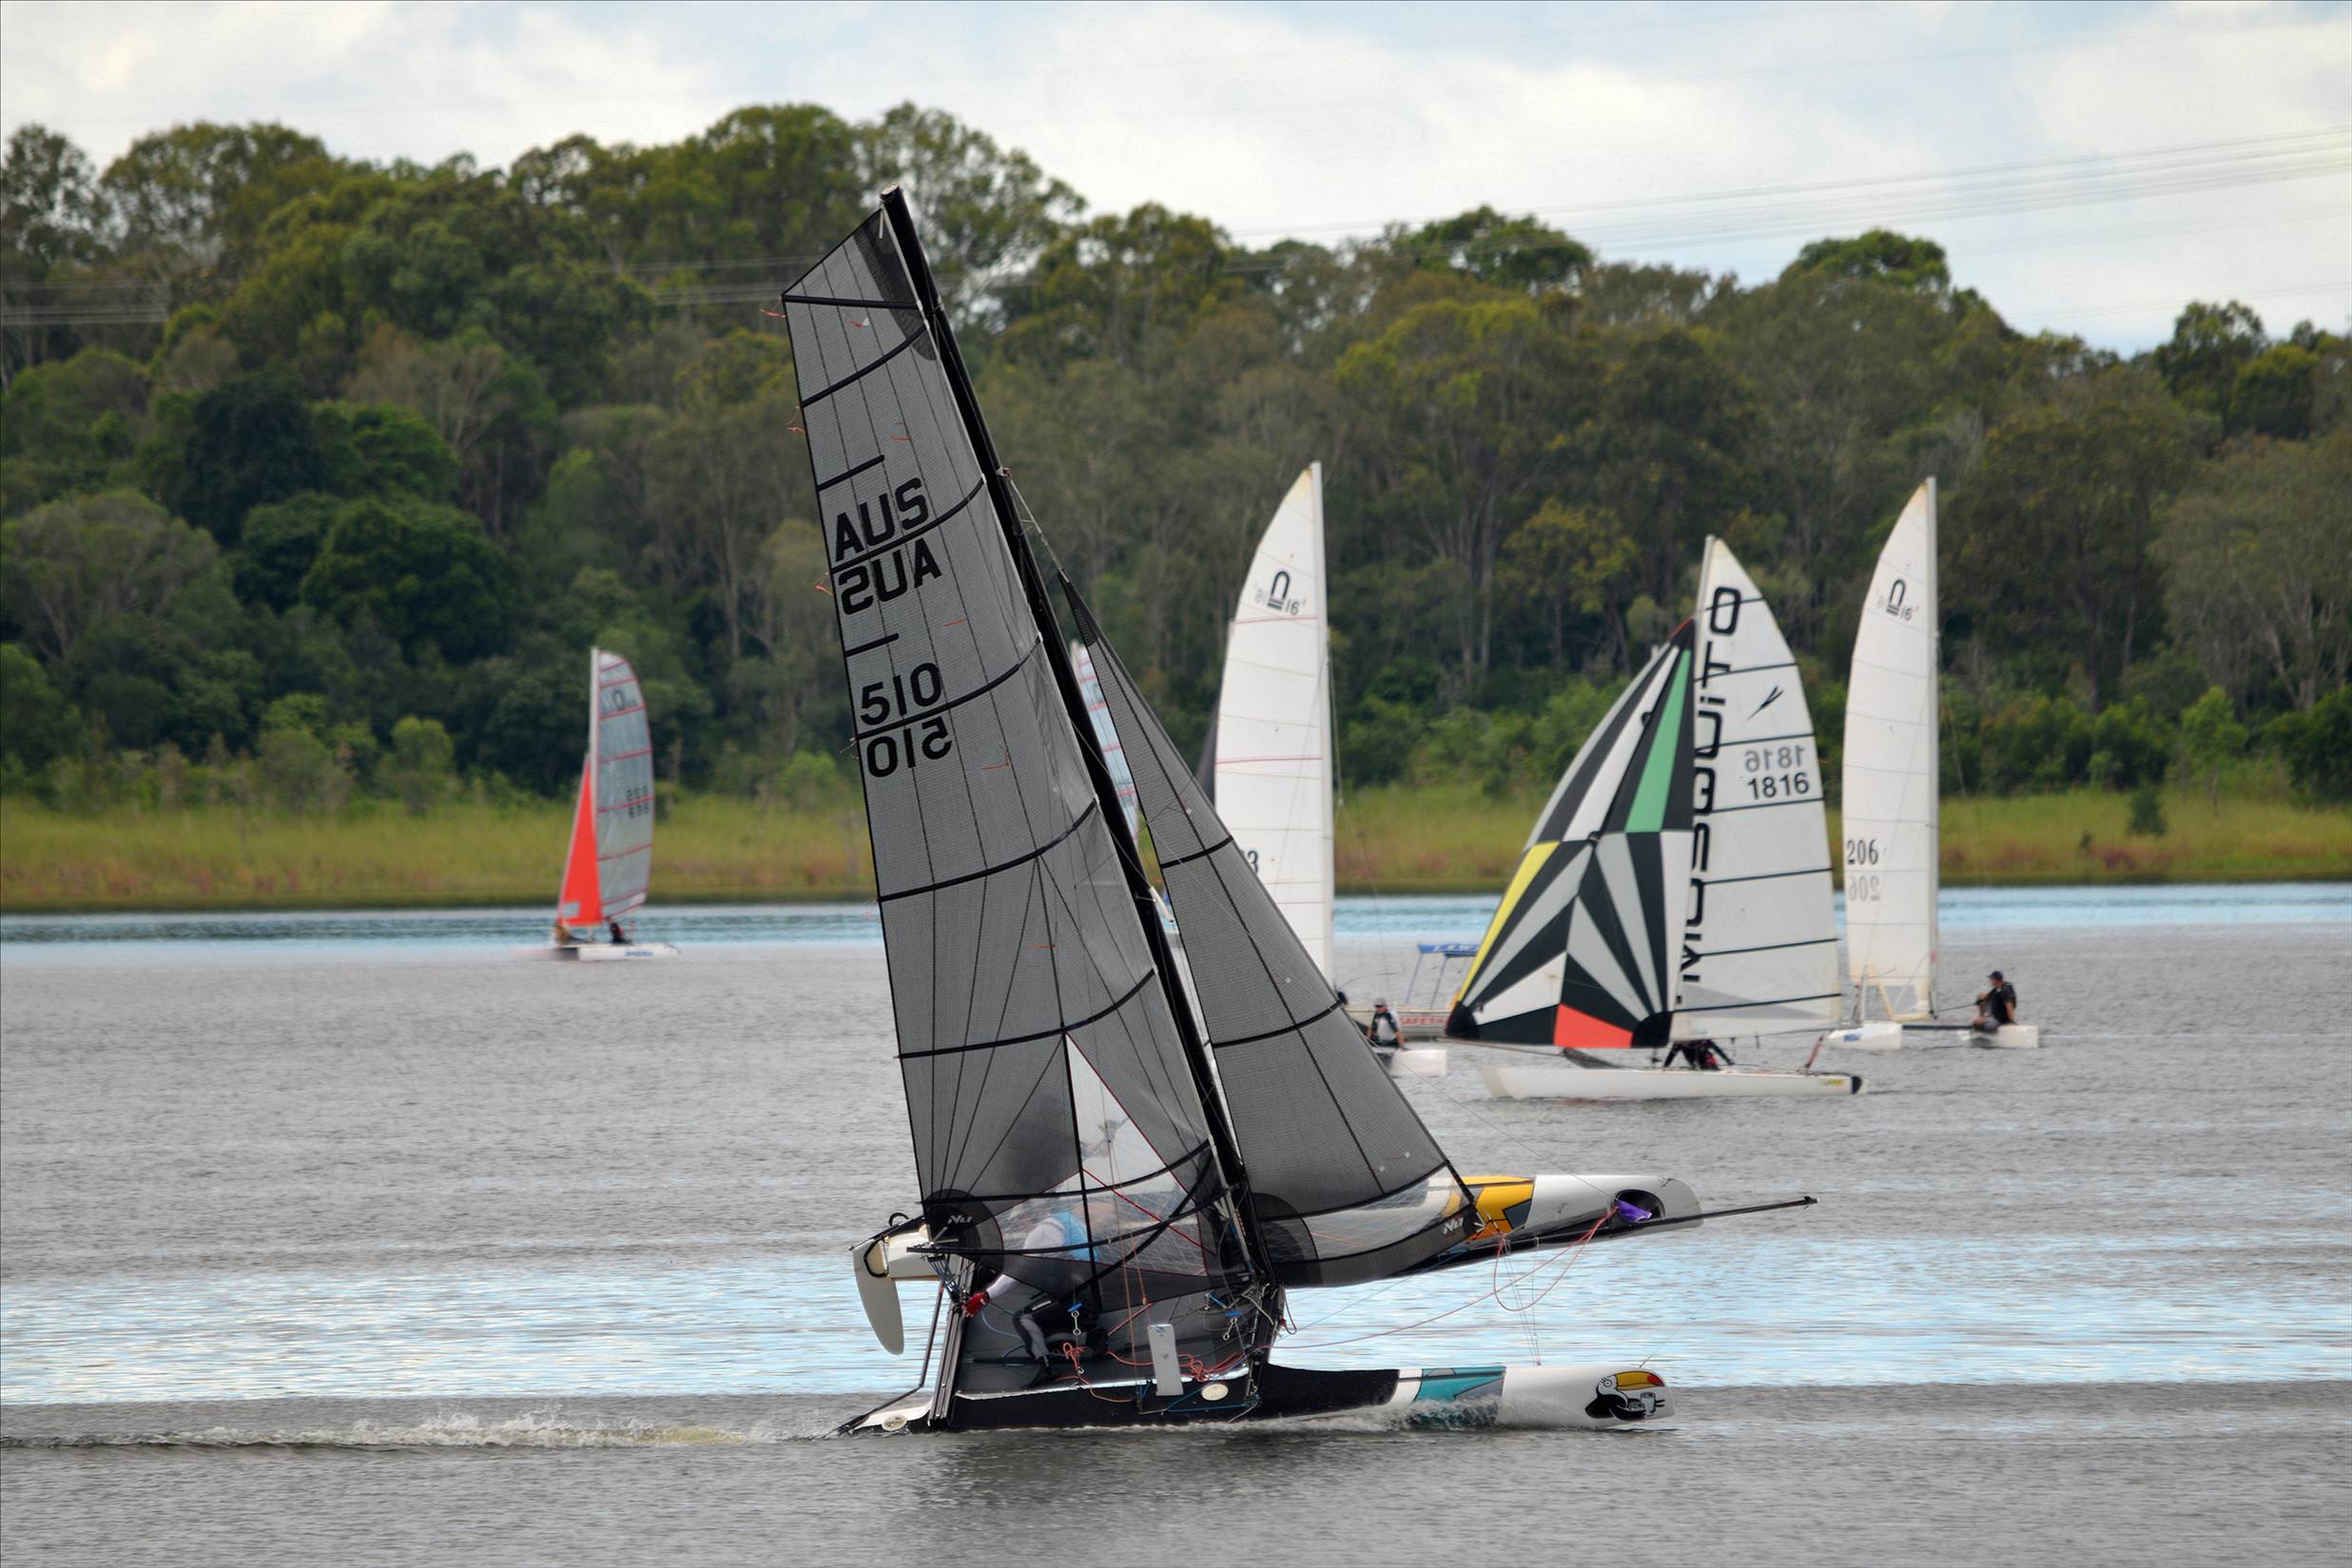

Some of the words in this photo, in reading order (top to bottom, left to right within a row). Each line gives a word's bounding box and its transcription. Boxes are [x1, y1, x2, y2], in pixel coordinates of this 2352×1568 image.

[835, 477, 929, 562] AUS
[860, 663, 943, 726] 510
[1747, 772, 1810, 800] 1816
[1847, 839, 1879, 865] 206
